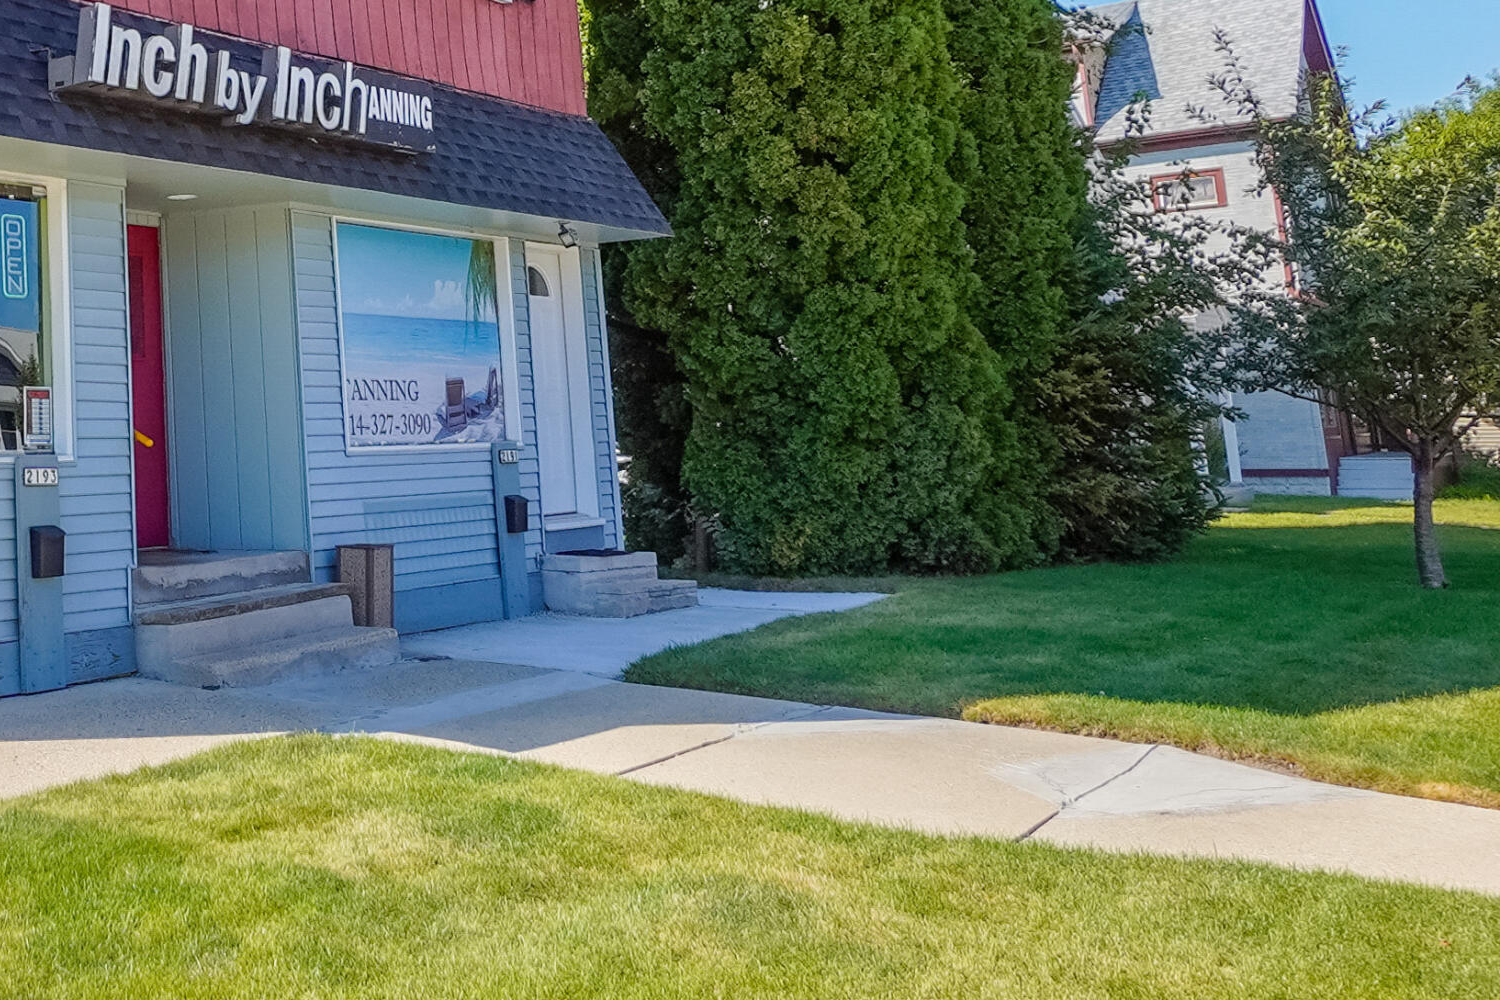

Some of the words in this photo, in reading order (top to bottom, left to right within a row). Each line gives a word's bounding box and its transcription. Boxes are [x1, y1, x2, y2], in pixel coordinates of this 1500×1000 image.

[88, 2, 209, 104] Inch
[214, 50, 269, 125] by
[272, 45, 368, 135] Inch
[366, 85, 434, 132] ANNING
[5, 219, 25, 294] OPEN
[346, 378, 420, 402] ANNING
[348, 413, 432, 436] 14-327-3090
[26, 469, 57, 484] 2193
